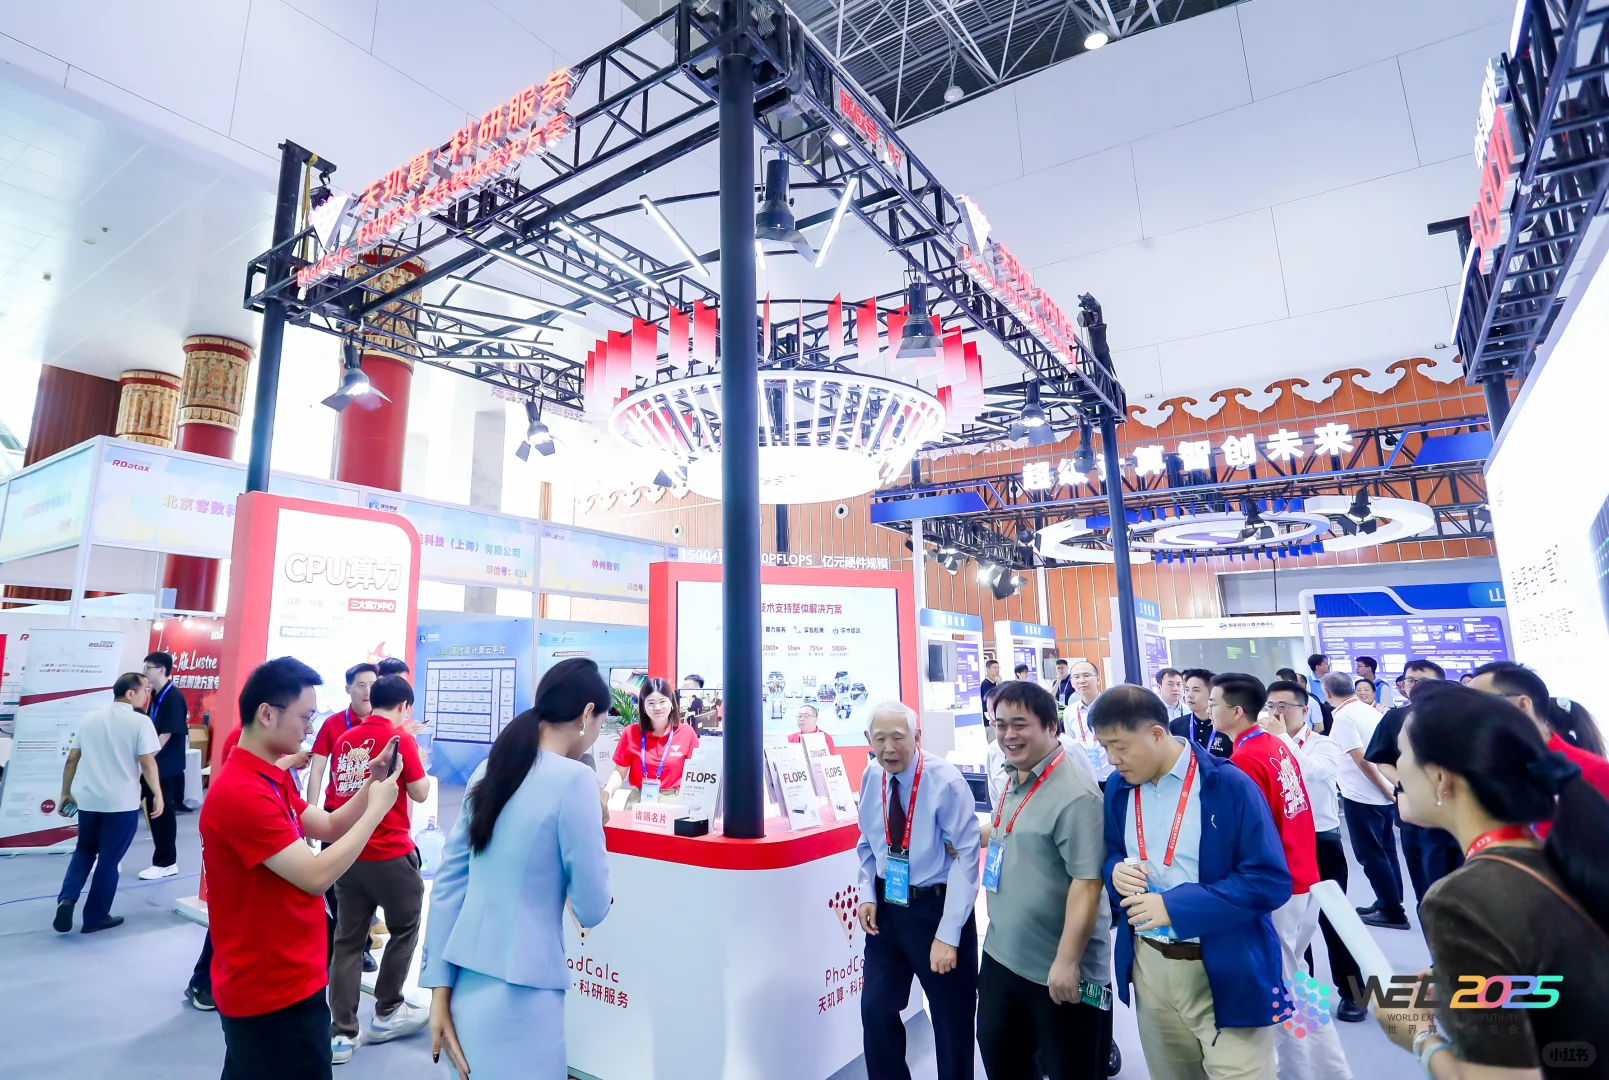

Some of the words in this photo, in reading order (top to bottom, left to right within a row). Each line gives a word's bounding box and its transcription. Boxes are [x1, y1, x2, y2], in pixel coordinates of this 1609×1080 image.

[112, 459, 149, 472] RDatax
[592, 559, 620, 572] 神州数码
[822, 554, 889, 570] 亿元硬件规模
[285, 553, 402, 591] CPU算力
[685, 771, 717, 784] FLOPS
[783, 771, 808, 783] FLOPS
[825, 766, 843, 778] FLOPS
